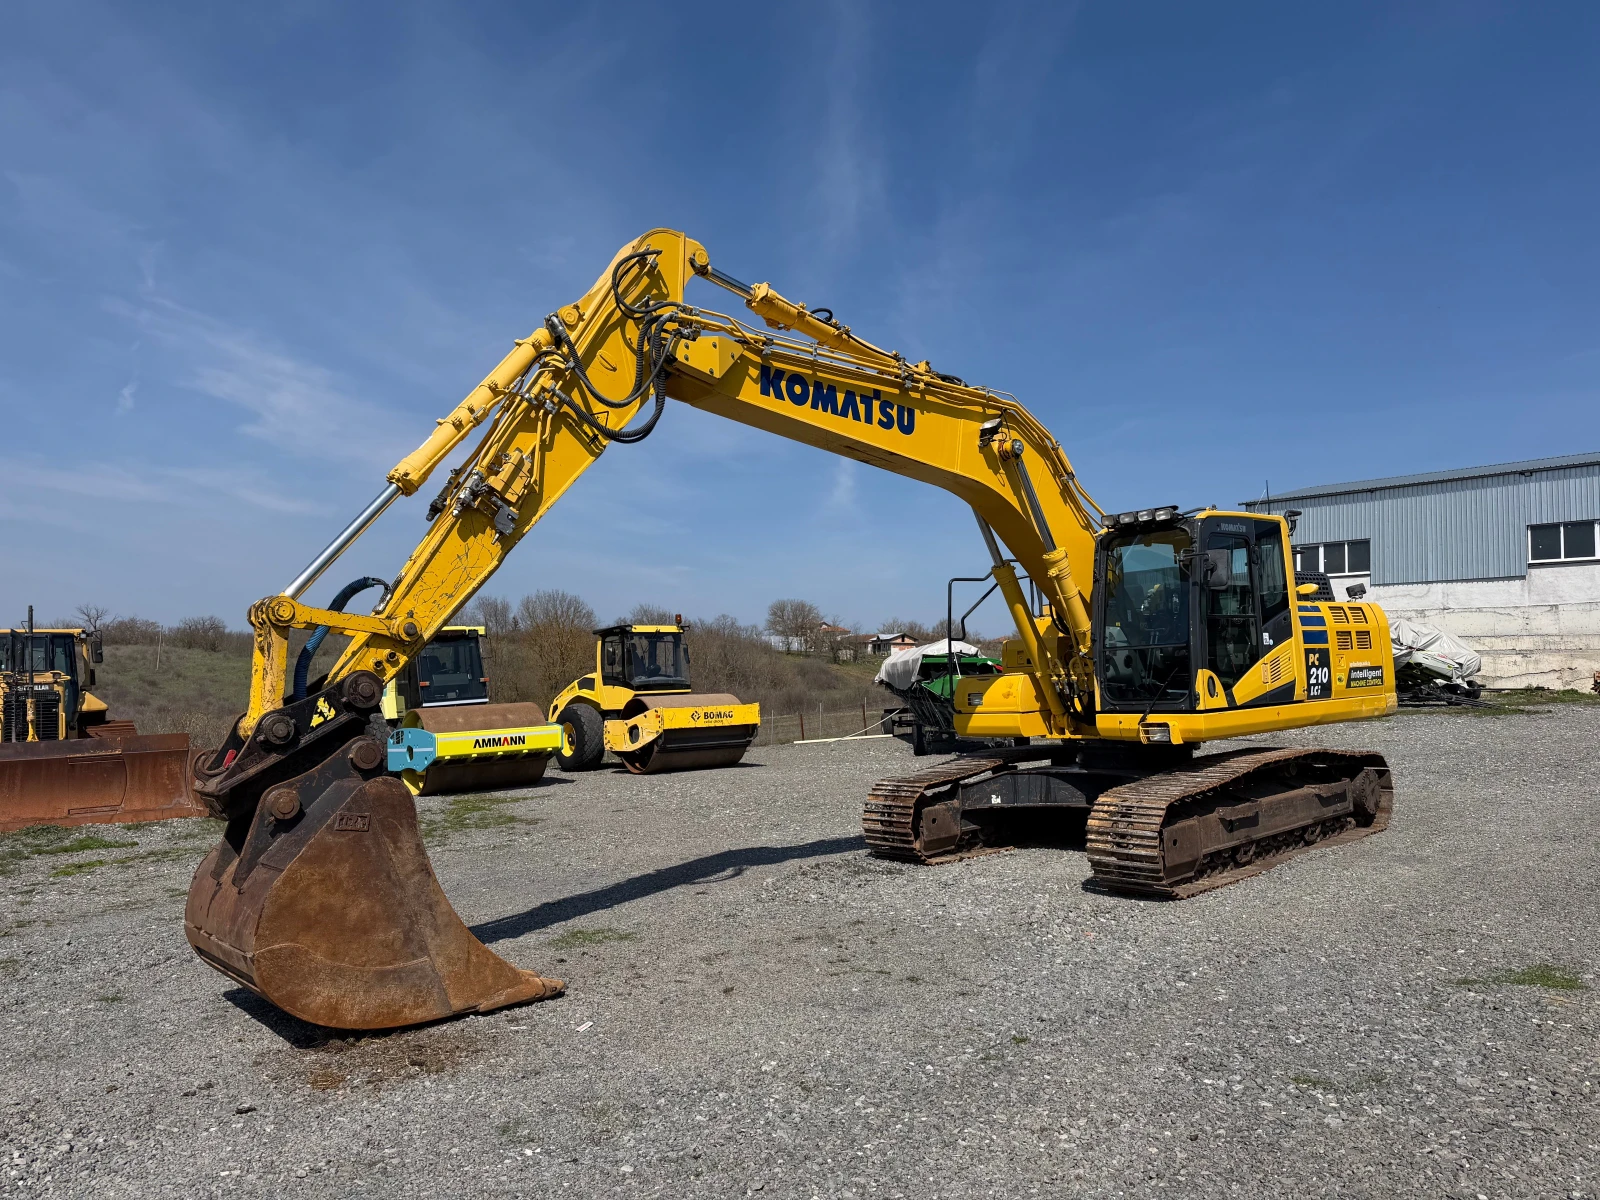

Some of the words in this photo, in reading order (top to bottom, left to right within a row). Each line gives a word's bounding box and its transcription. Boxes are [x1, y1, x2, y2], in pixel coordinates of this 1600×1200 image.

[760, 364, 915, 436] KOMATSU
[1308, 653, 1319, 666] PC
[1310, 667, 1329, 684] 210
[1351, 668, 1382, 679] intelligent
[703, 711, 733, 720] BOMAG
[473, 735, 526, 749] AMMANN
